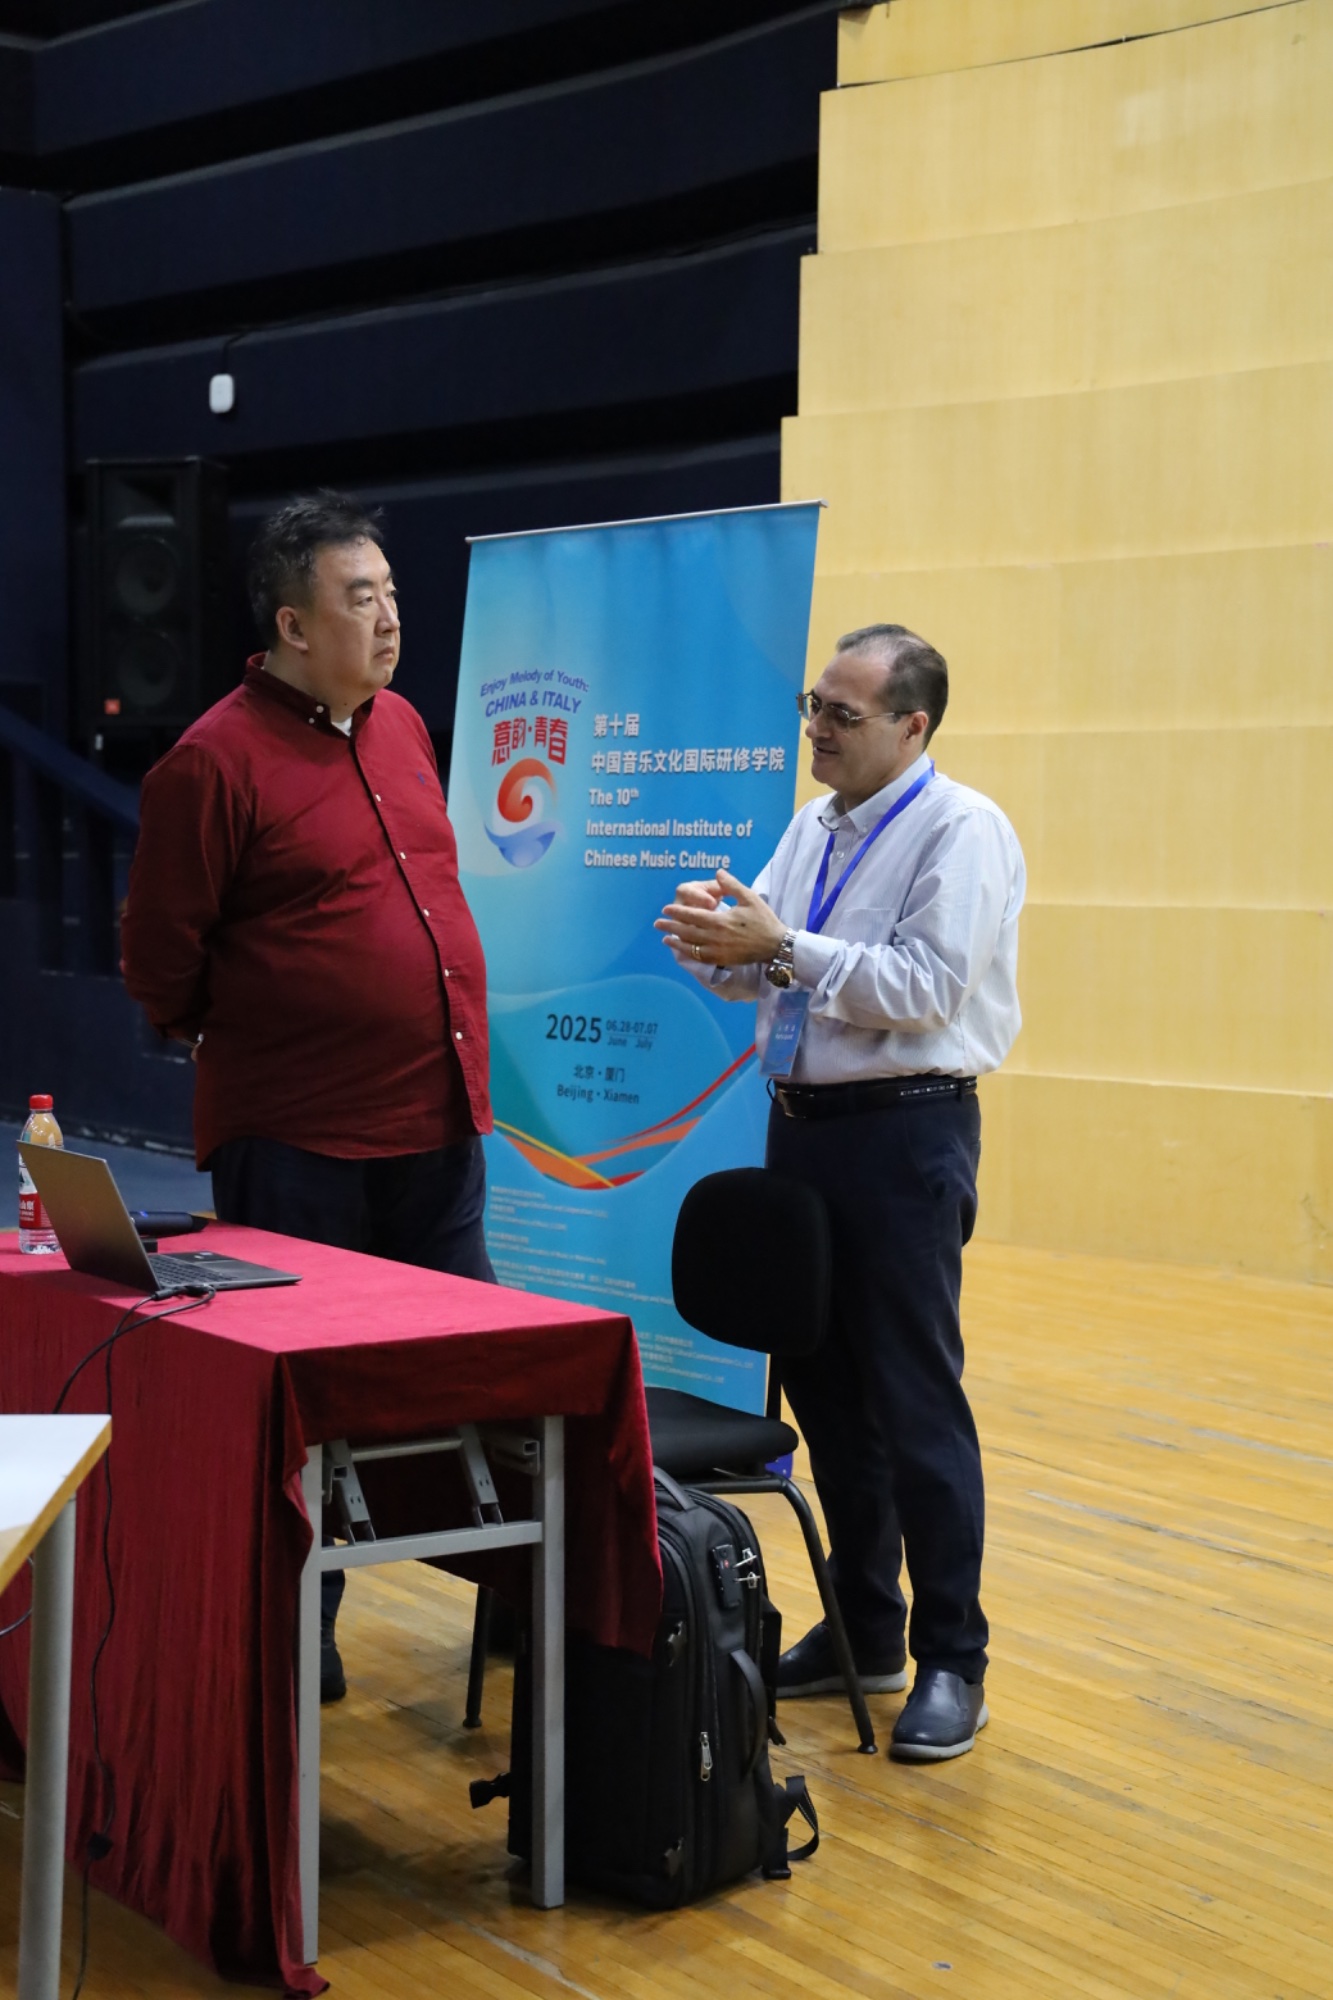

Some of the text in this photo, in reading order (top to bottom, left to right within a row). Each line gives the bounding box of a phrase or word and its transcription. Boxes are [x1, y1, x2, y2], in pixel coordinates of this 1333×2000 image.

[481, 669, 589, 697] Enjoy Melody of Youth:
[485, 690, 582, 717] CHINA & ITALY
[593, 713, 640, 737] 第十届
[591, 746, 785, 774] 中国音乐文化国际研修学院
[589, 788, 639, 805] The 10th
[586, 819, 753, 837] International Institute of
[584, 849, 730, 869] Chinese Music Culture
[546, 1013, 602, 1044] 2025
[607, 1036, 653, 1052] June July
[557, 1083, 640, 1105] Beijing Xiamen
